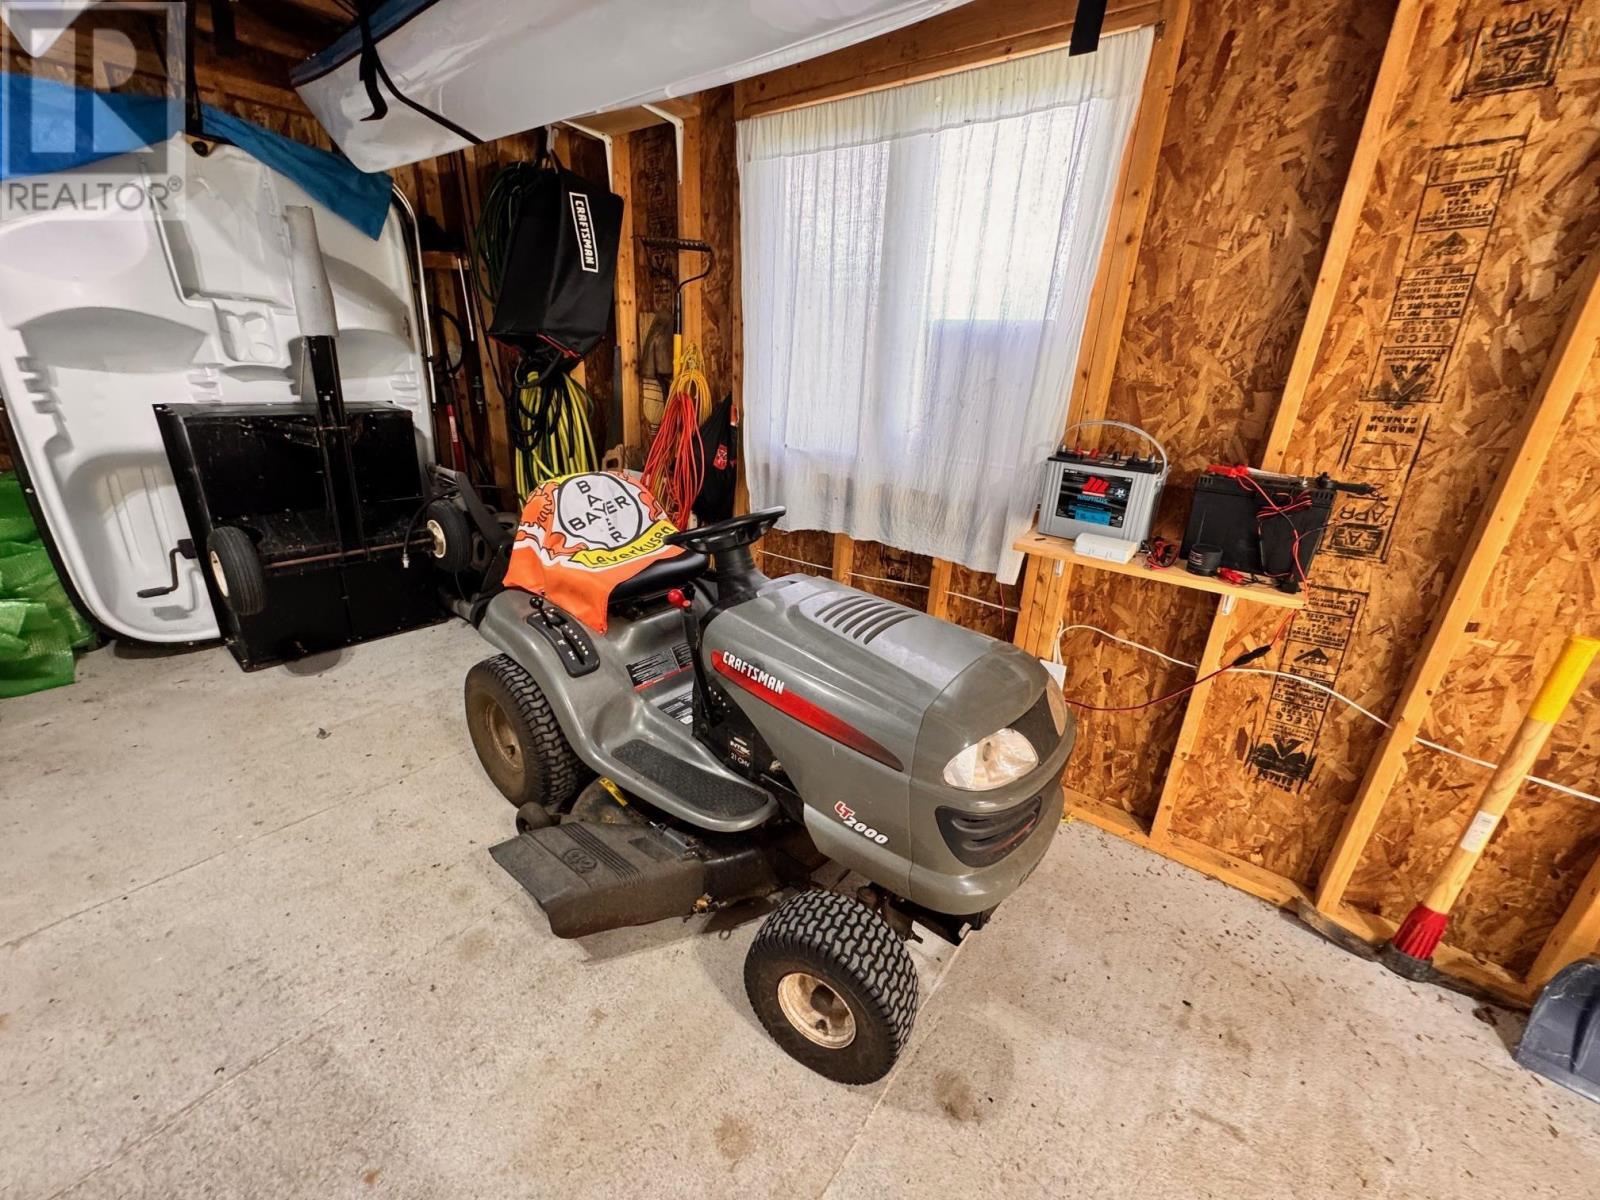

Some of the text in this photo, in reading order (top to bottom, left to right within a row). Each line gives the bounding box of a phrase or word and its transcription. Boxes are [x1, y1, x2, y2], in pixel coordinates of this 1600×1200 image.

[575, 199, 595, 265] CRAFTSMAN
[1393, 333, 1443, 343] TECO
[1381, 425, 1416, 434] MADE
[569, 495, 631, 531] BAYER
[583, 525, 674, 566] Leverkusen
[722, 651, 785, 695] CRAFTSMAN
